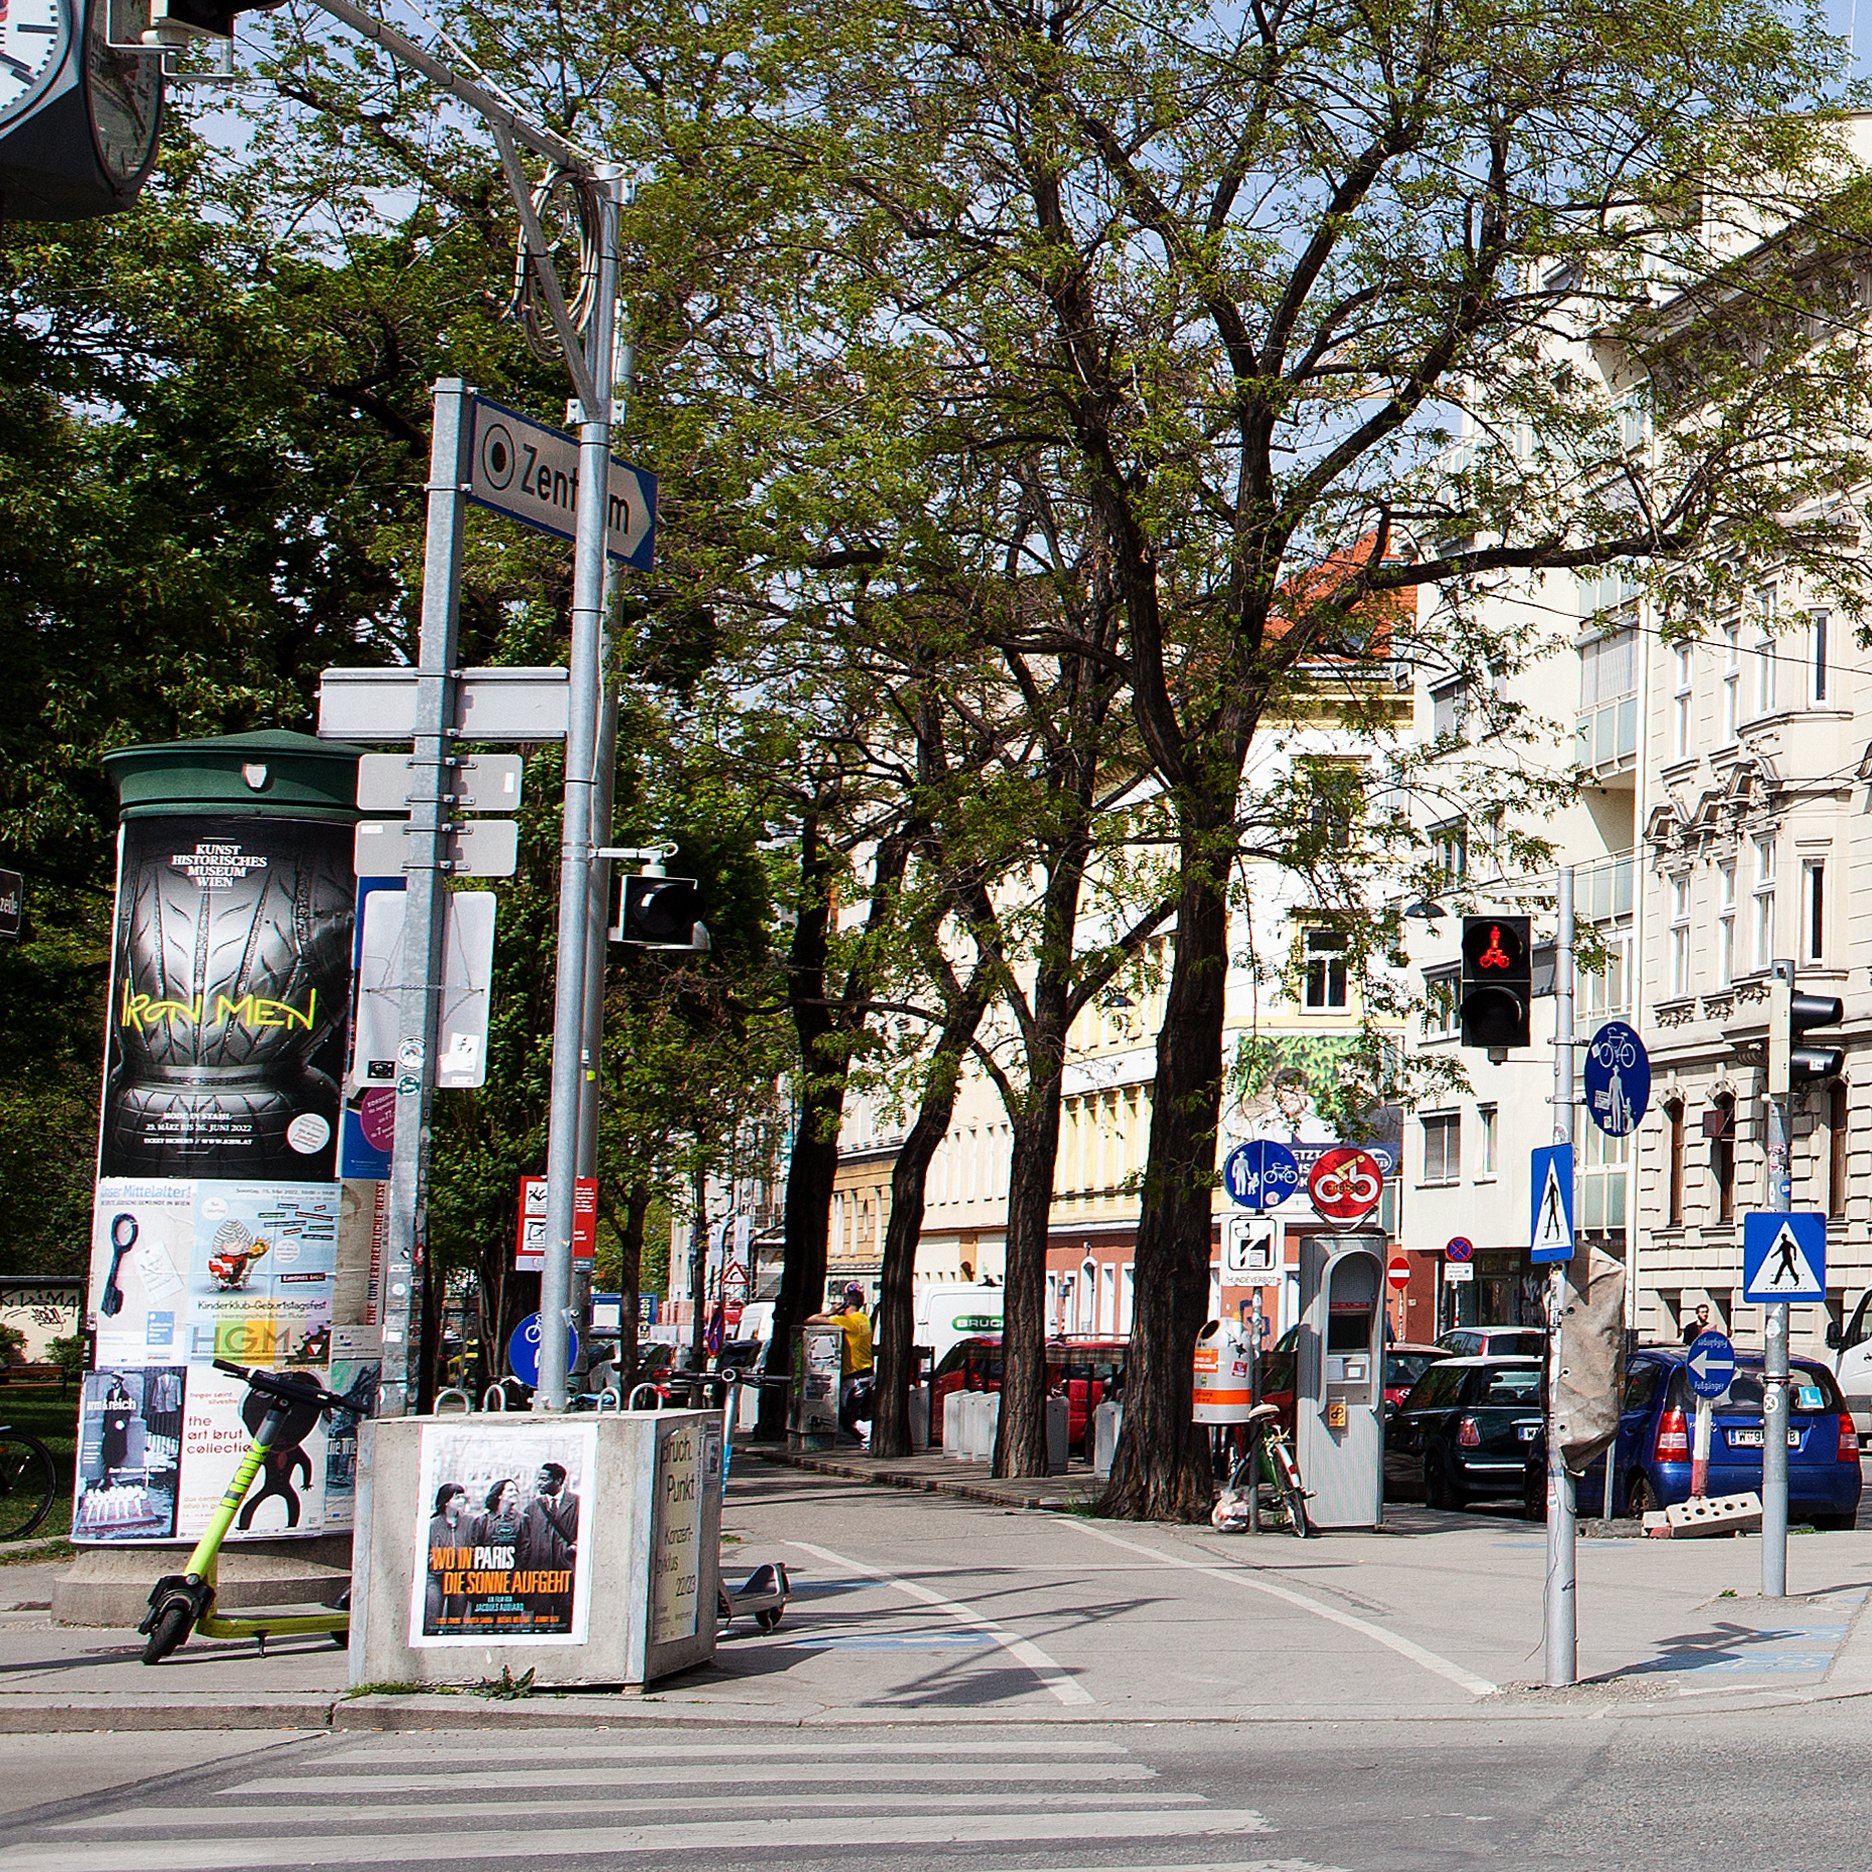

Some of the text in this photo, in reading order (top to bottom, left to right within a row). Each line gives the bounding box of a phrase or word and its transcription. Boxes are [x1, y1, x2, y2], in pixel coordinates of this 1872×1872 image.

[520, 442, 631, 535] Zentm
[194, 844, 242, 856] KUNST
[171, 855, 269, 868] HISTORISCHES
[186, 866, 247, 878] MUSEUM
[195, 877, 234, 888] WIEN
[215, 987, 317, 1031] MEN
[1293, 1149, 1323, 1160] ETZT
[123, 1184, 191, 1199] Mittelalter!
[192, 1326, 292, 1354] HGM
[1804, 1387, 1817, 1403] L
[188, 1415, 212, 1427] the
[212, 1428, 243, 1440] brut
[186, 1442, 252, 1454] collectio
[666, 1472, 695, 1504] Punkt
[431, 1546, 516, 1570] WO IN PARIS
[443, 1570, 573, 1596] DIE SONNE AUFGEHT
